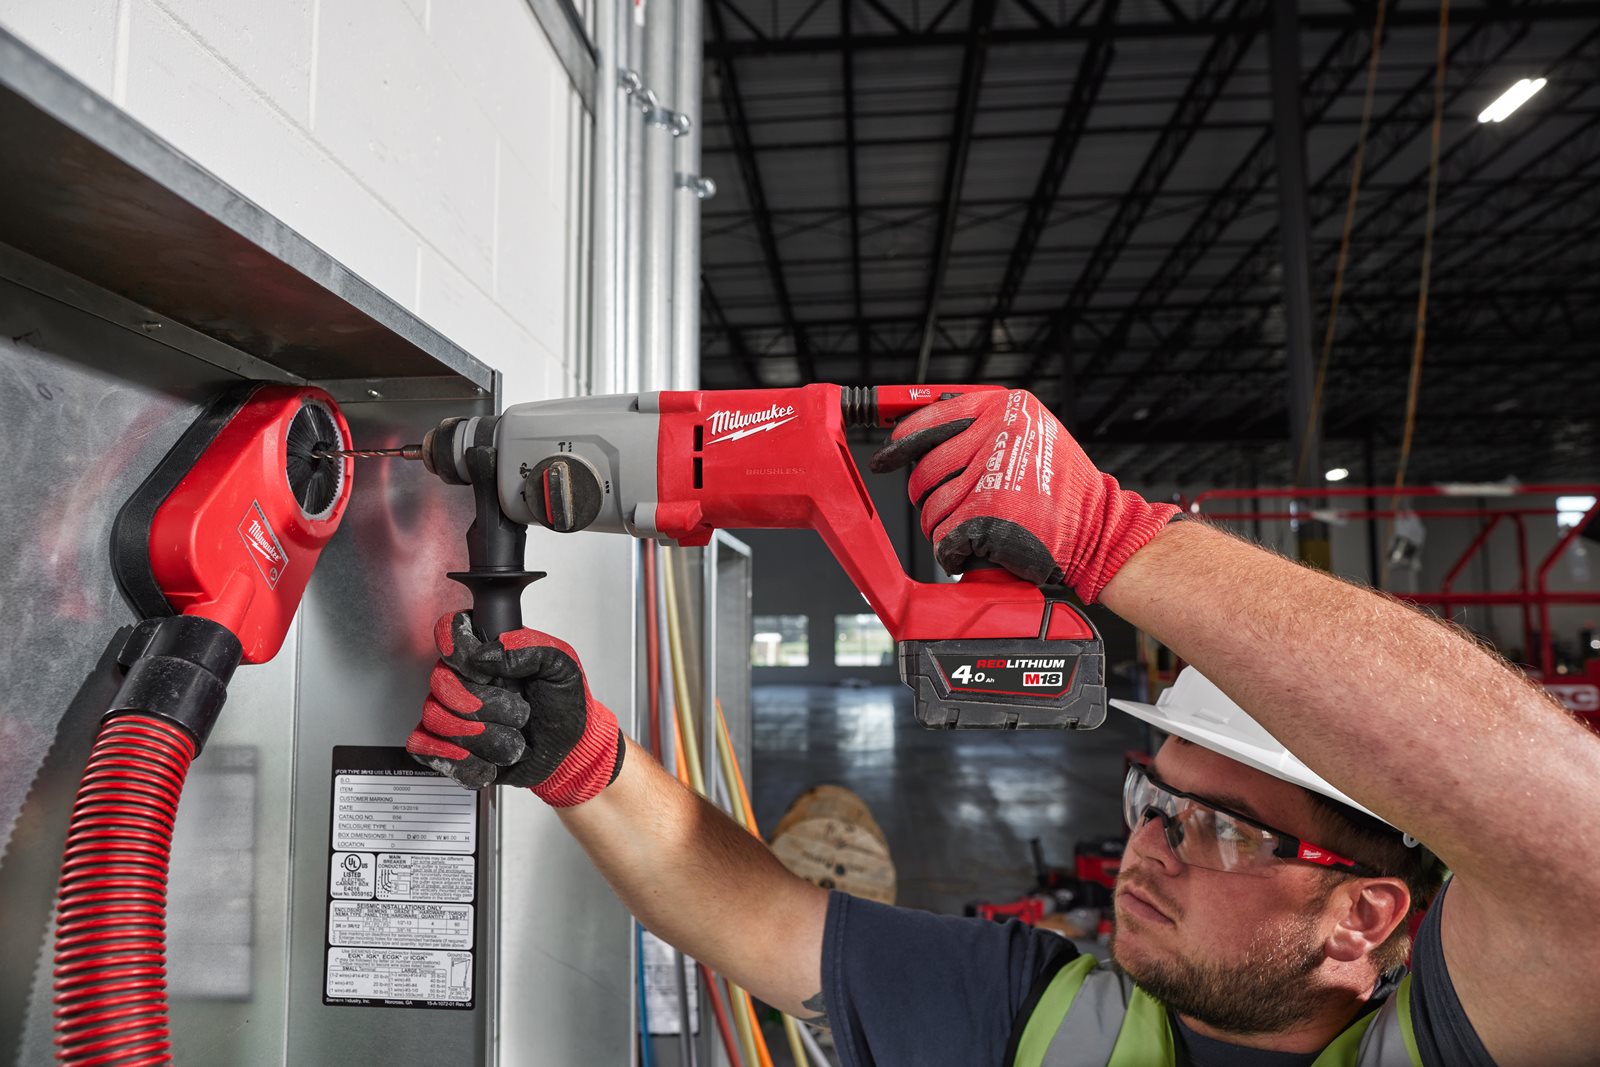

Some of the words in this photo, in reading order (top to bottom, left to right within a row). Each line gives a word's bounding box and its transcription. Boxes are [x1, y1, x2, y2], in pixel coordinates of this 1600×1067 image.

[706, 404, 795, 436] Milwaukee
[1008, 413, 1018, 426] XL
[1028, 430, 1036, 450] CUT
[1042, 410, 1058, 496] Milwaukee
[746, 468, 807, 476] BRUSHLESS
[1018, 452, 1030, 482] LEVEL
[248, 520, 282, 562] Milwaukee
[1024, 673, 1062, 685] M18
[348, 858, 357, 868] UL
